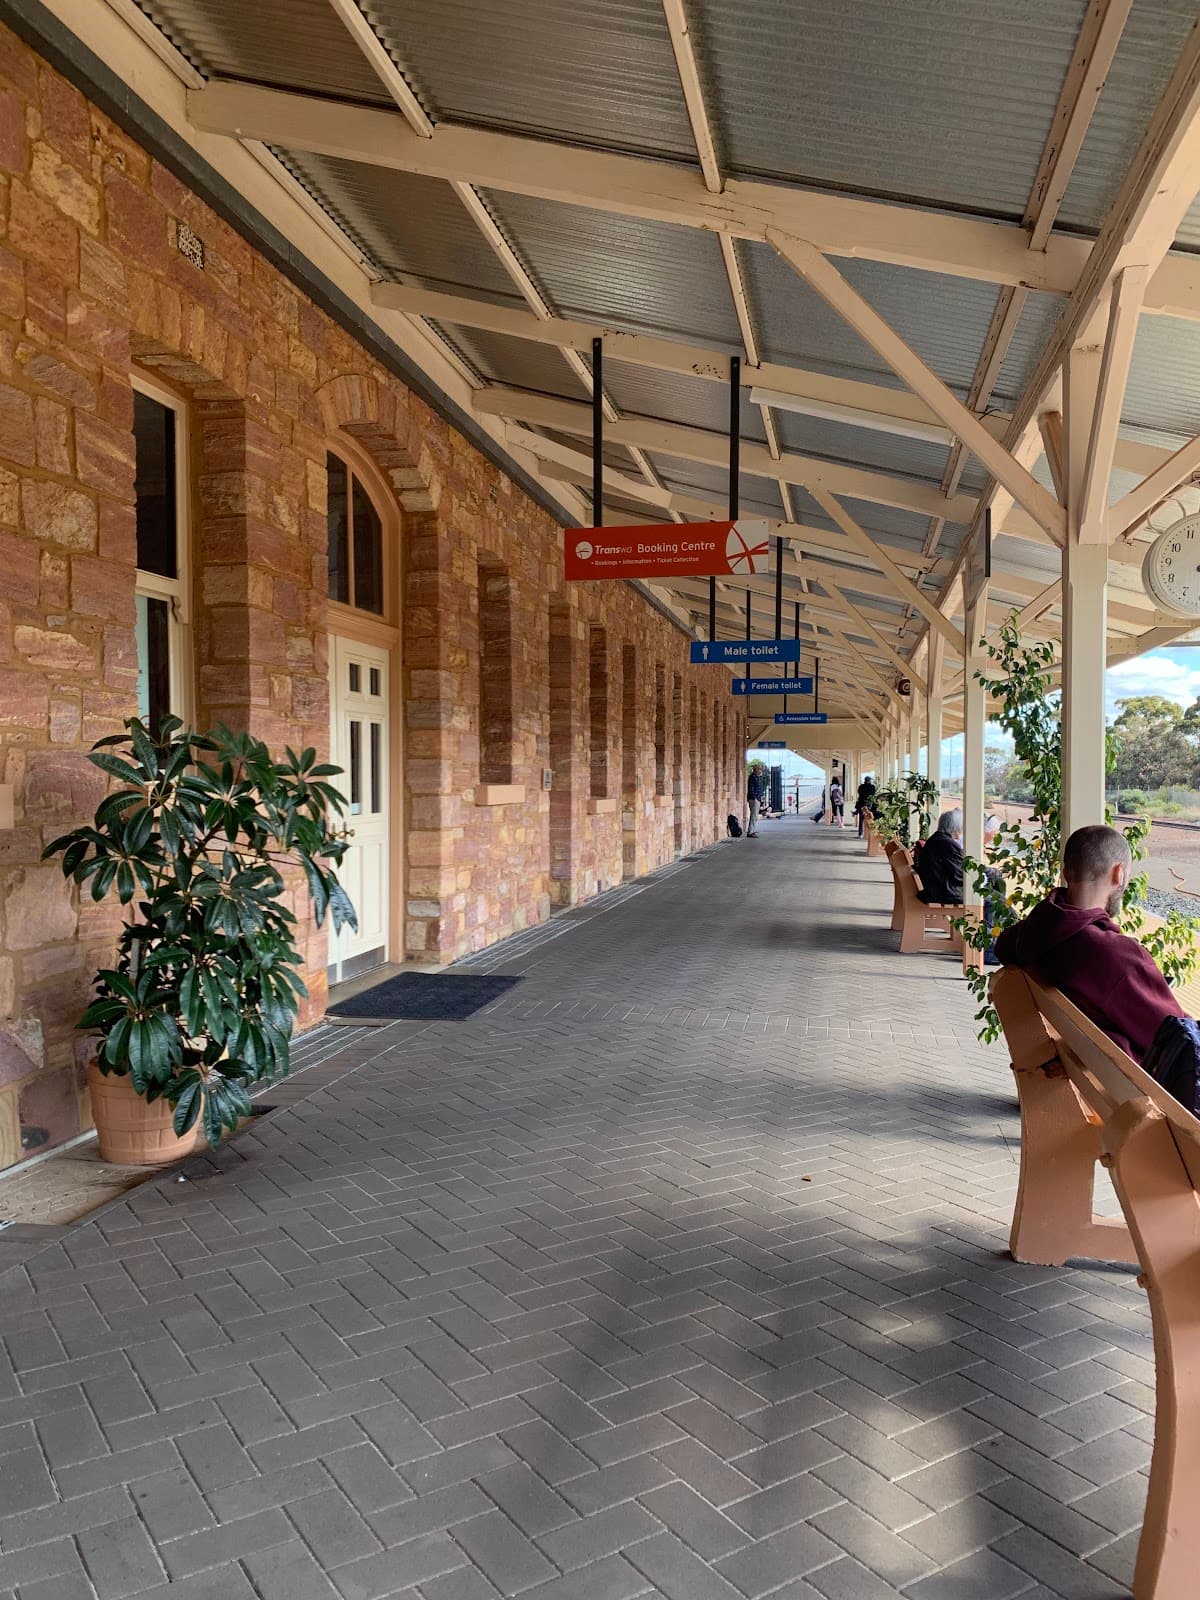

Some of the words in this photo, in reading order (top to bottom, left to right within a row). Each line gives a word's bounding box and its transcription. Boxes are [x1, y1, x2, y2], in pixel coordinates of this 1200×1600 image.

[1186, 529, 1195, 539] 11
[594, 544, 633, 555] Transwa
[637, 543, 678, 554] Booking
[681, 541, 716, 551] Centre
[1171, 543, 1181, 553] 10
[1165, 557, 1172, 566] 9
[1168, 573, 1175, 583] 8
[1182, 586, 1190, 596] 7
[724, 646, 748, 656] Male
[751, 645, 779, 655] toilet
[751, 682, 779, 690] Female
[781, 681, 802, 689] toilet
